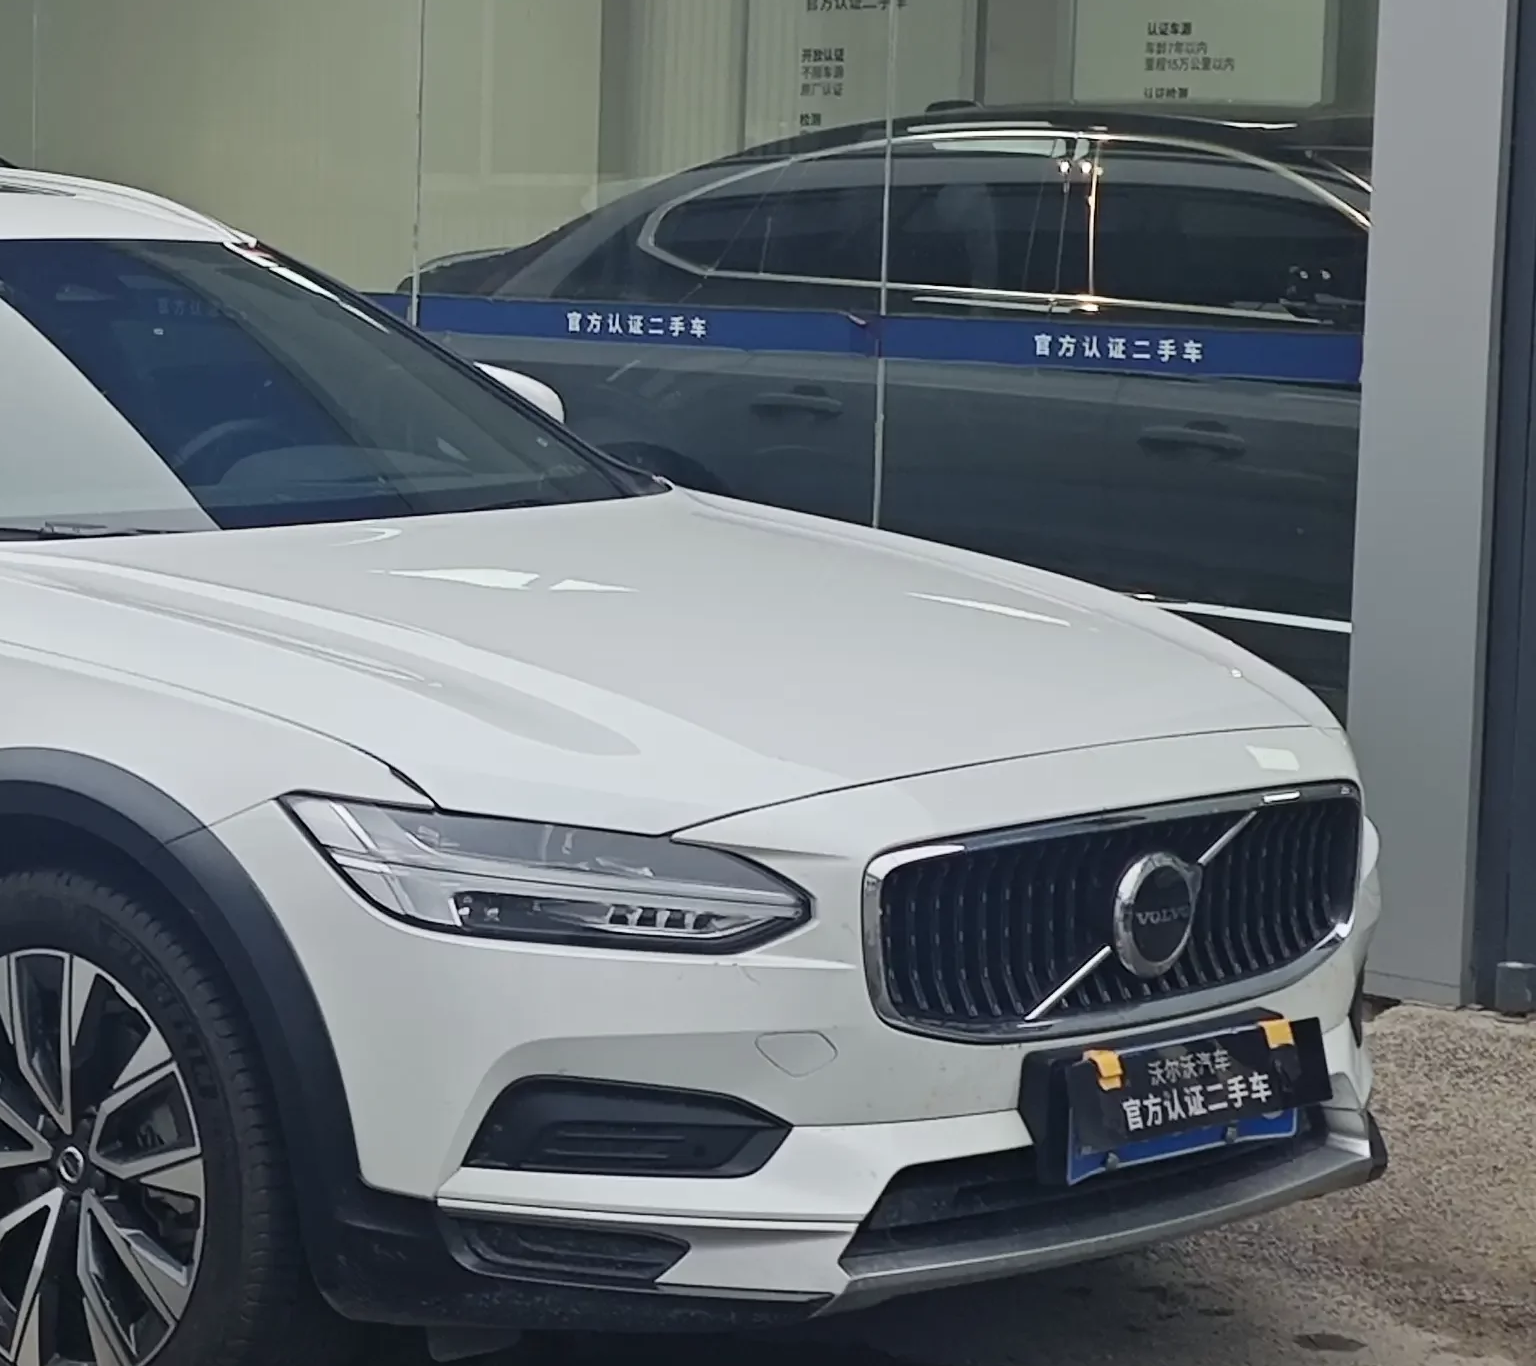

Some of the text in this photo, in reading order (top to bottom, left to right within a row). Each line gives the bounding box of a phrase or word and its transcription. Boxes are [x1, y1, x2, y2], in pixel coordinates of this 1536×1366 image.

[567, 311, 706, 338] 官方认证二手车
[1034, 333, 1202, 363] 官方认证二手车
[1135, 905, 1191, 925] VOLVO
[1148, 1048, 1232, 1086] 沃尔沃汽车
[1122, 1071, 1273, 1132] 官方认证二手车
